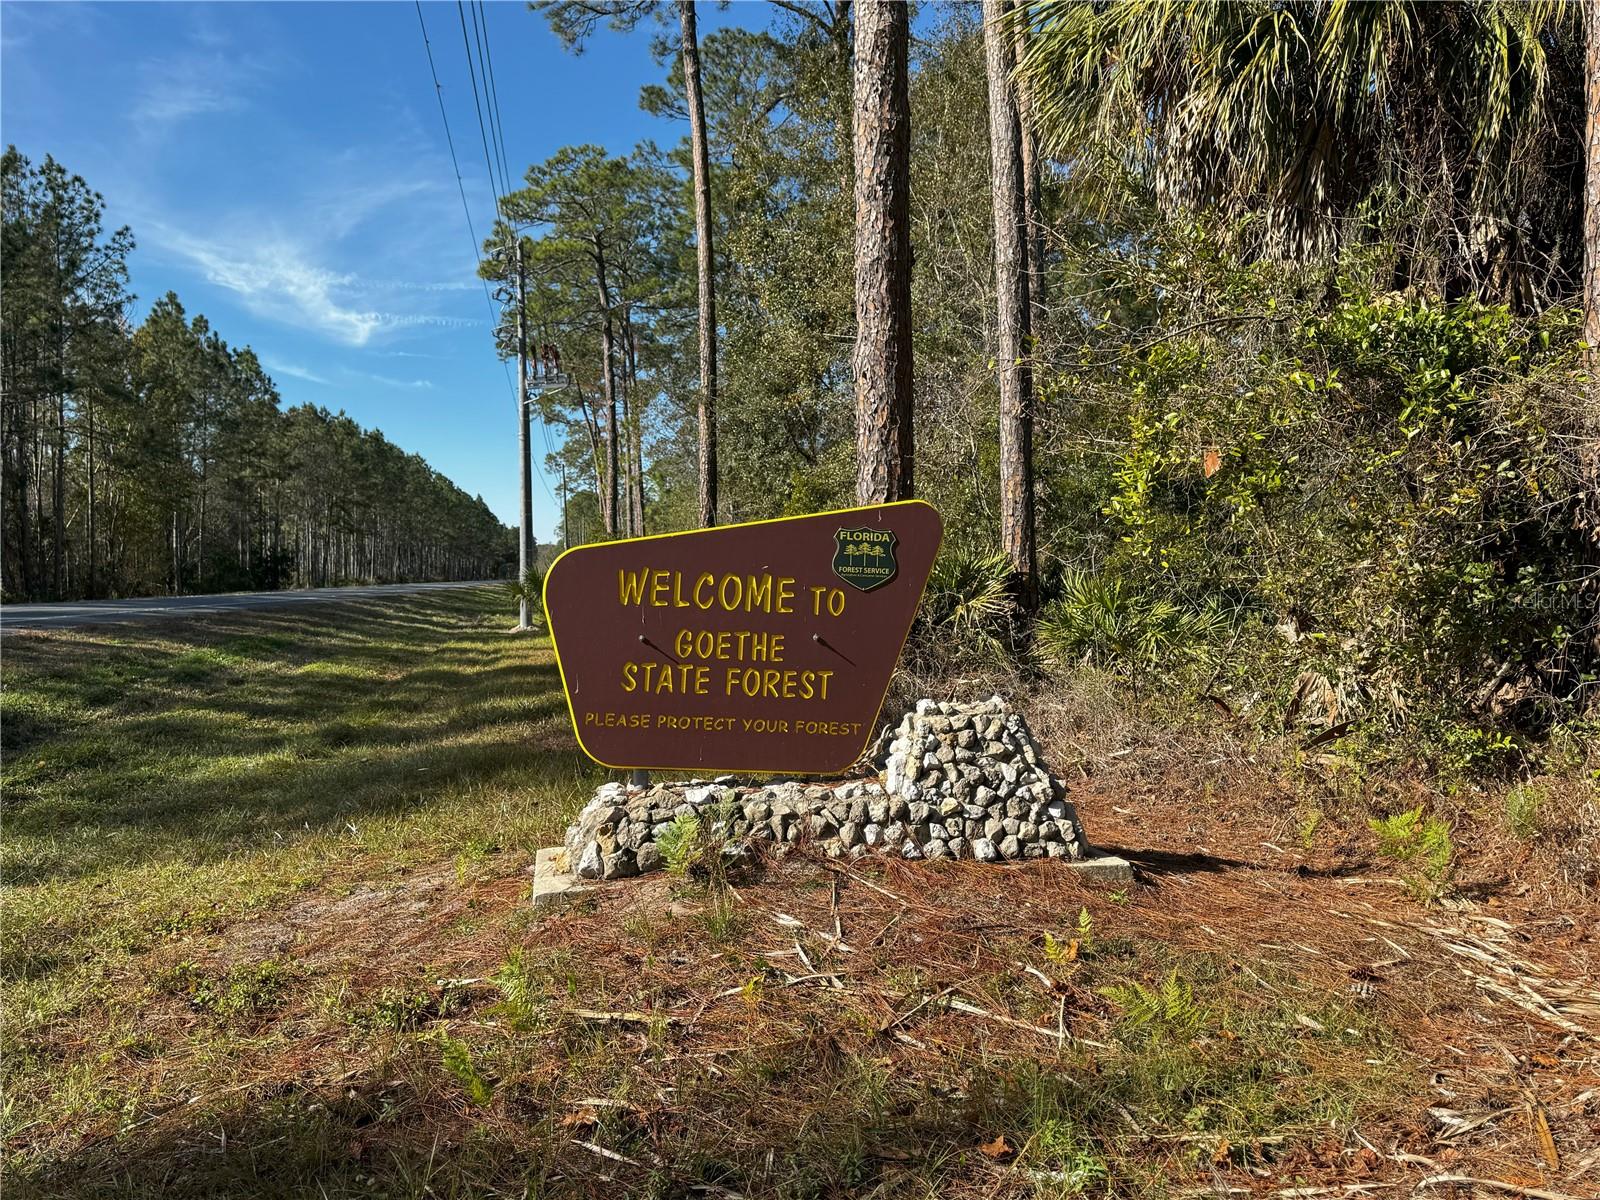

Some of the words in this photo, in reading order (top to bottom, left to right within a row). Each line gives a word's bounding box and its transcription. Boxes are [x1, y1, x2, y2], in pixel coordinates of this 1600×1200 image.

[840, 531, 890, 542] FLORIDA
[618, 567, 795, 614] WELCOME
[810, 585, 846, 617] TO
[674, 628, 785, 662] GOETHE
[620, 662, 711, 695] STATE
[725, 669, 834, 700] FOREST
[584, 712, 651, 729] PLEASE
[656, 715, 736, 732] PROTECT
[743, 719, 789, 733] YOUR
[795, 720, 862, 736] FOREST
